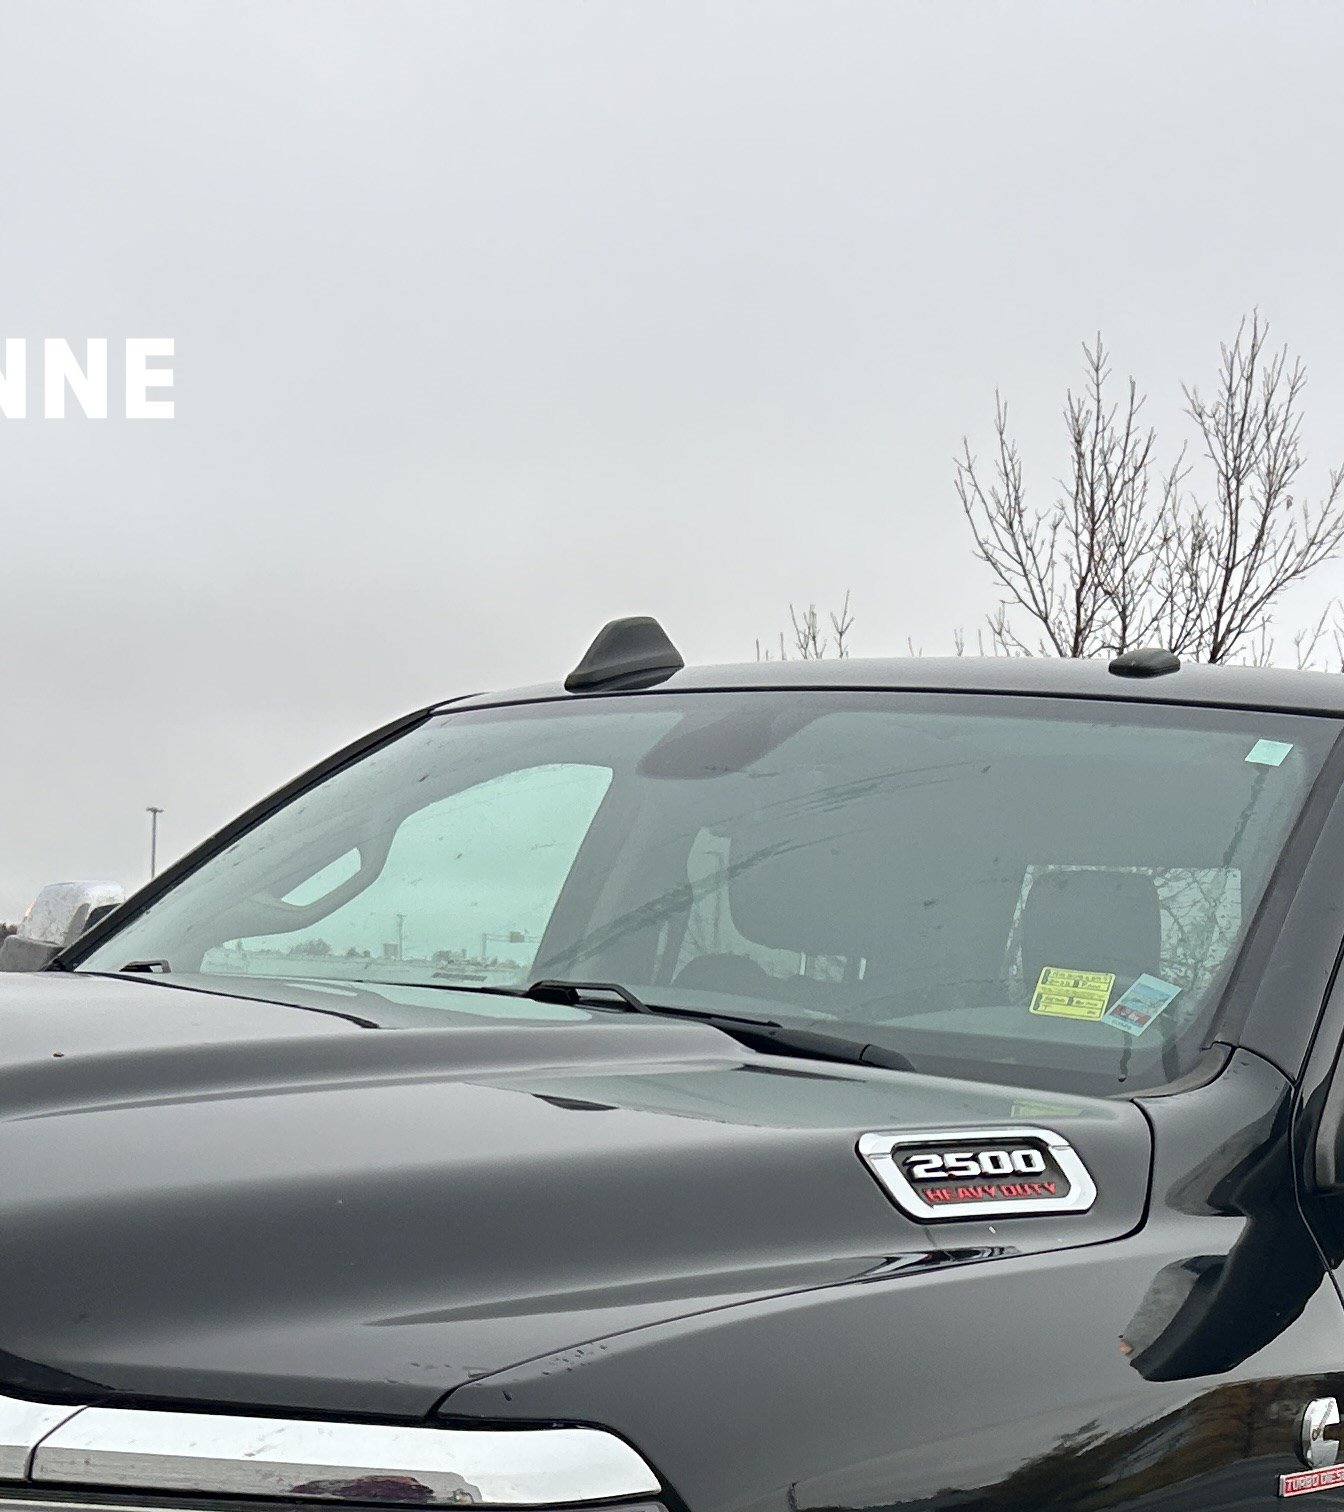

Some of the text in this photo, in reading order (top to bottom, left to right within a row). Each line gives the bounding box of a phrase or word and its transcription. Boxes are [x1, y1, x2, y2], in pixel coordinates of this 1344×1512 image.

[903, 1148, 1047, 1182] 2500
[922, 1181, 1056, 1202] HEAVY DUTY
